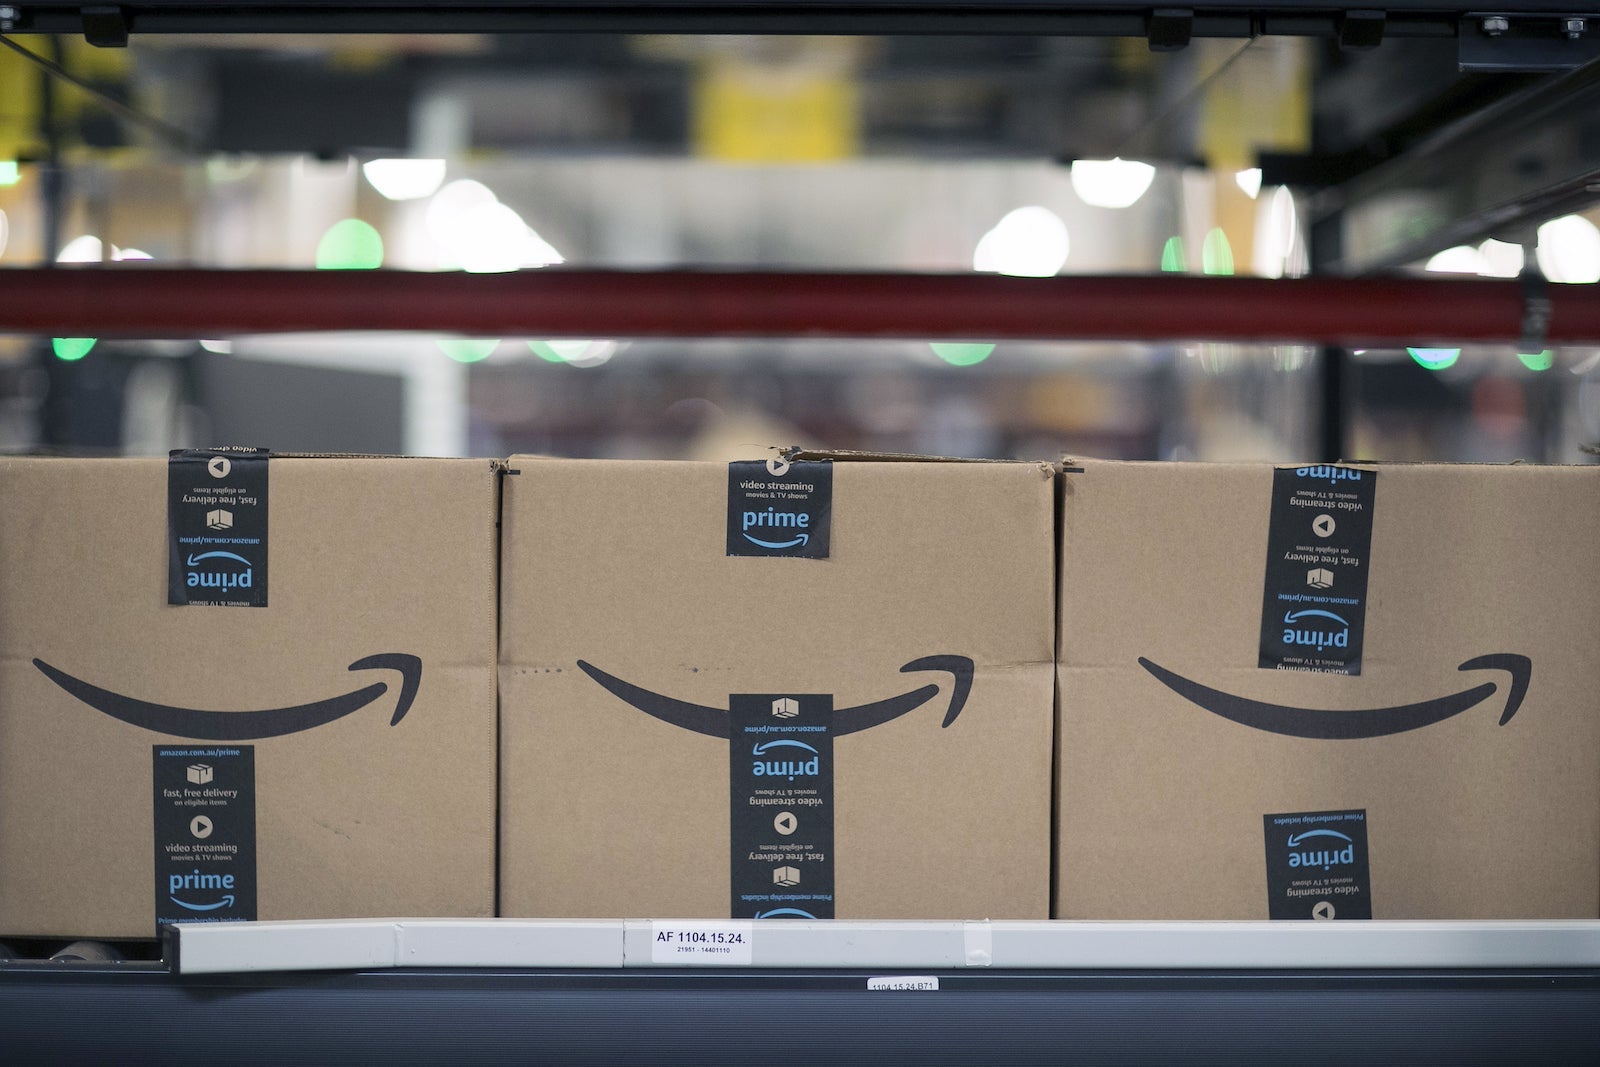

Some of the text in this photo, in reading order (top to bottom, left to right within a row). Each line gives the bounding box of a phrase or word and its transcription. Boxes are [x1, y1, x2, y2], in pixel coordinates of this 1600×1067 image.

[740, 480, 814, 492] video streaming
[182, 495, 257, 506] fast, free delivery
[1334, 492, 1358, 500] movies
[1290, 497, 1363, 511] video streaming
[743, 507, 809, 530] prime
[1316, 546, 1338, 554] eligible
[1284, 551, 1359, 567] fast, free delivery
[187, 569, 251, 592] prime
[1278, 593, 1359, 605] amazon.com.au/prime
[1282, 628, 1349, 651] prime
[1283, 656, 1303, 664] shows
[1321, 659, 1344, 667] movies
[752, 757, 819, 781] prime
[163, 789, 237, 798] fast, free delivery
[750, 797, 823, 806] video streaming
[1274, 817, 1301, 825] includes
[1303, 815, 1343, 823] membership
[165, 844, 238, 853] video streaming
[749, 853, 824, 862] fast, free delivery
[1288, 844, 1353, 870] prime
[170, 869, 234, 893] prime
[1287, 886, 1359, 898] video streaming
[657, 931, 745, 943] AF 1104.15.24.
